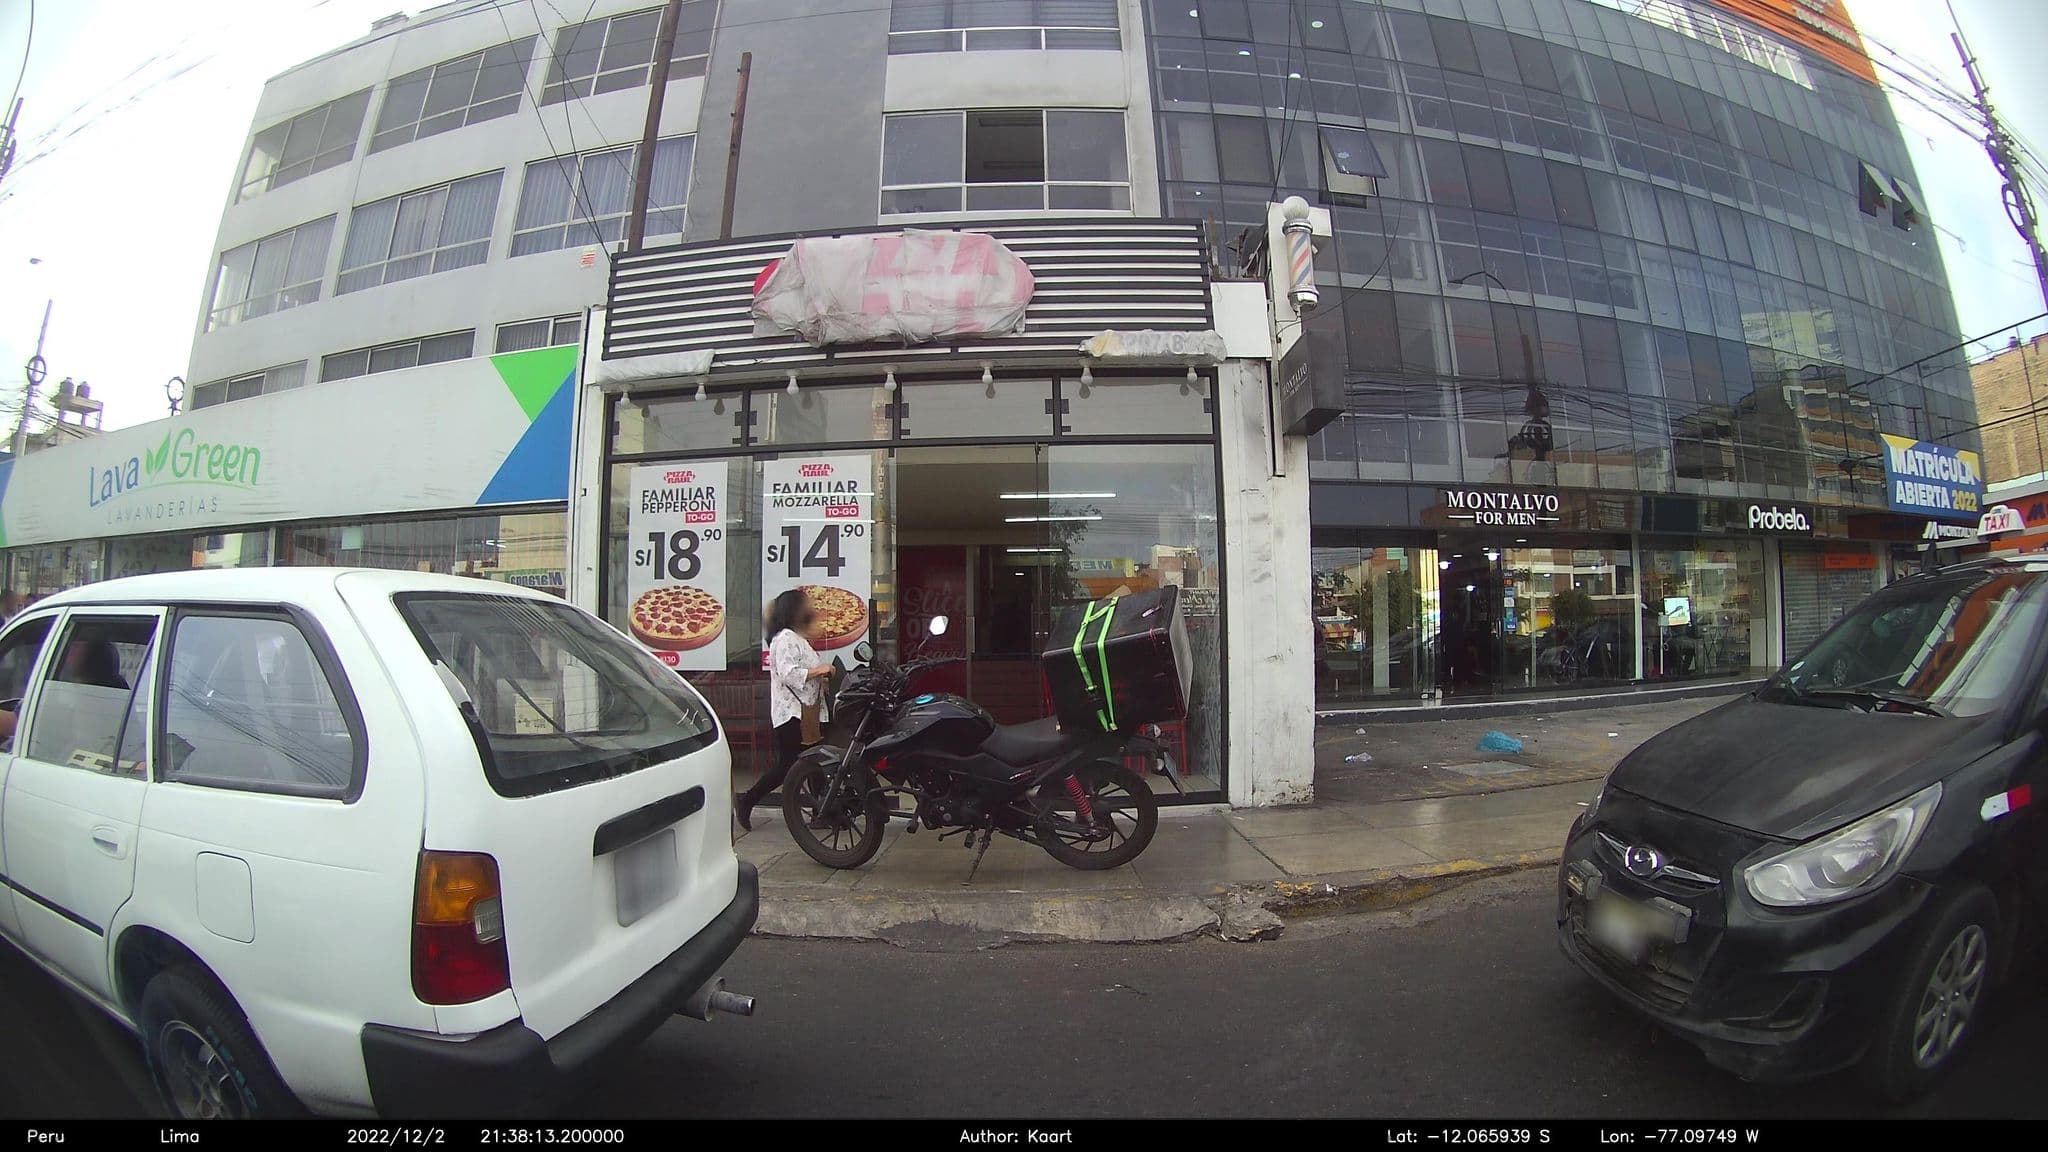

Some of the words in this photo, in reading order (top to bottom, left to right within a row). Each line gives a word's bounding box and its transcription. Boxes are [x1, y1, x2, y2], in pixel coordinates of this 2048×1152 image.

[89, 456, 139, 507] Lava
[171, 427, 262, 486] Green
[801, 463, 830, 471] PIZZA
[1889, 447, 1975, 485] MATRÍCULA
[666, 470, 692, 478] PIZZA
[642, 486, 715, 503] FAMILIAR
[773, 480, 857, 494] FAMILIAR
[773, 495, 858, 508] MOZZARELLA
[1447, 491, 1559, 512] MONTALVO
[1895, 480, 1951, 509] ABIERTA
[1952, 489, 1978, 512] 2022
[642, 499, 716, 514] PEPPERONI
[827, 508, 857, 516] TO-GO
[686, 513, 714, 522] TO-GO
[1475, 511, 1503, 525] FOR
[1507, 512, 1536, 525] MEN
[1748, 505, 1810, 530] Probela.
[1984, 513, 2010, 532] TAXI
